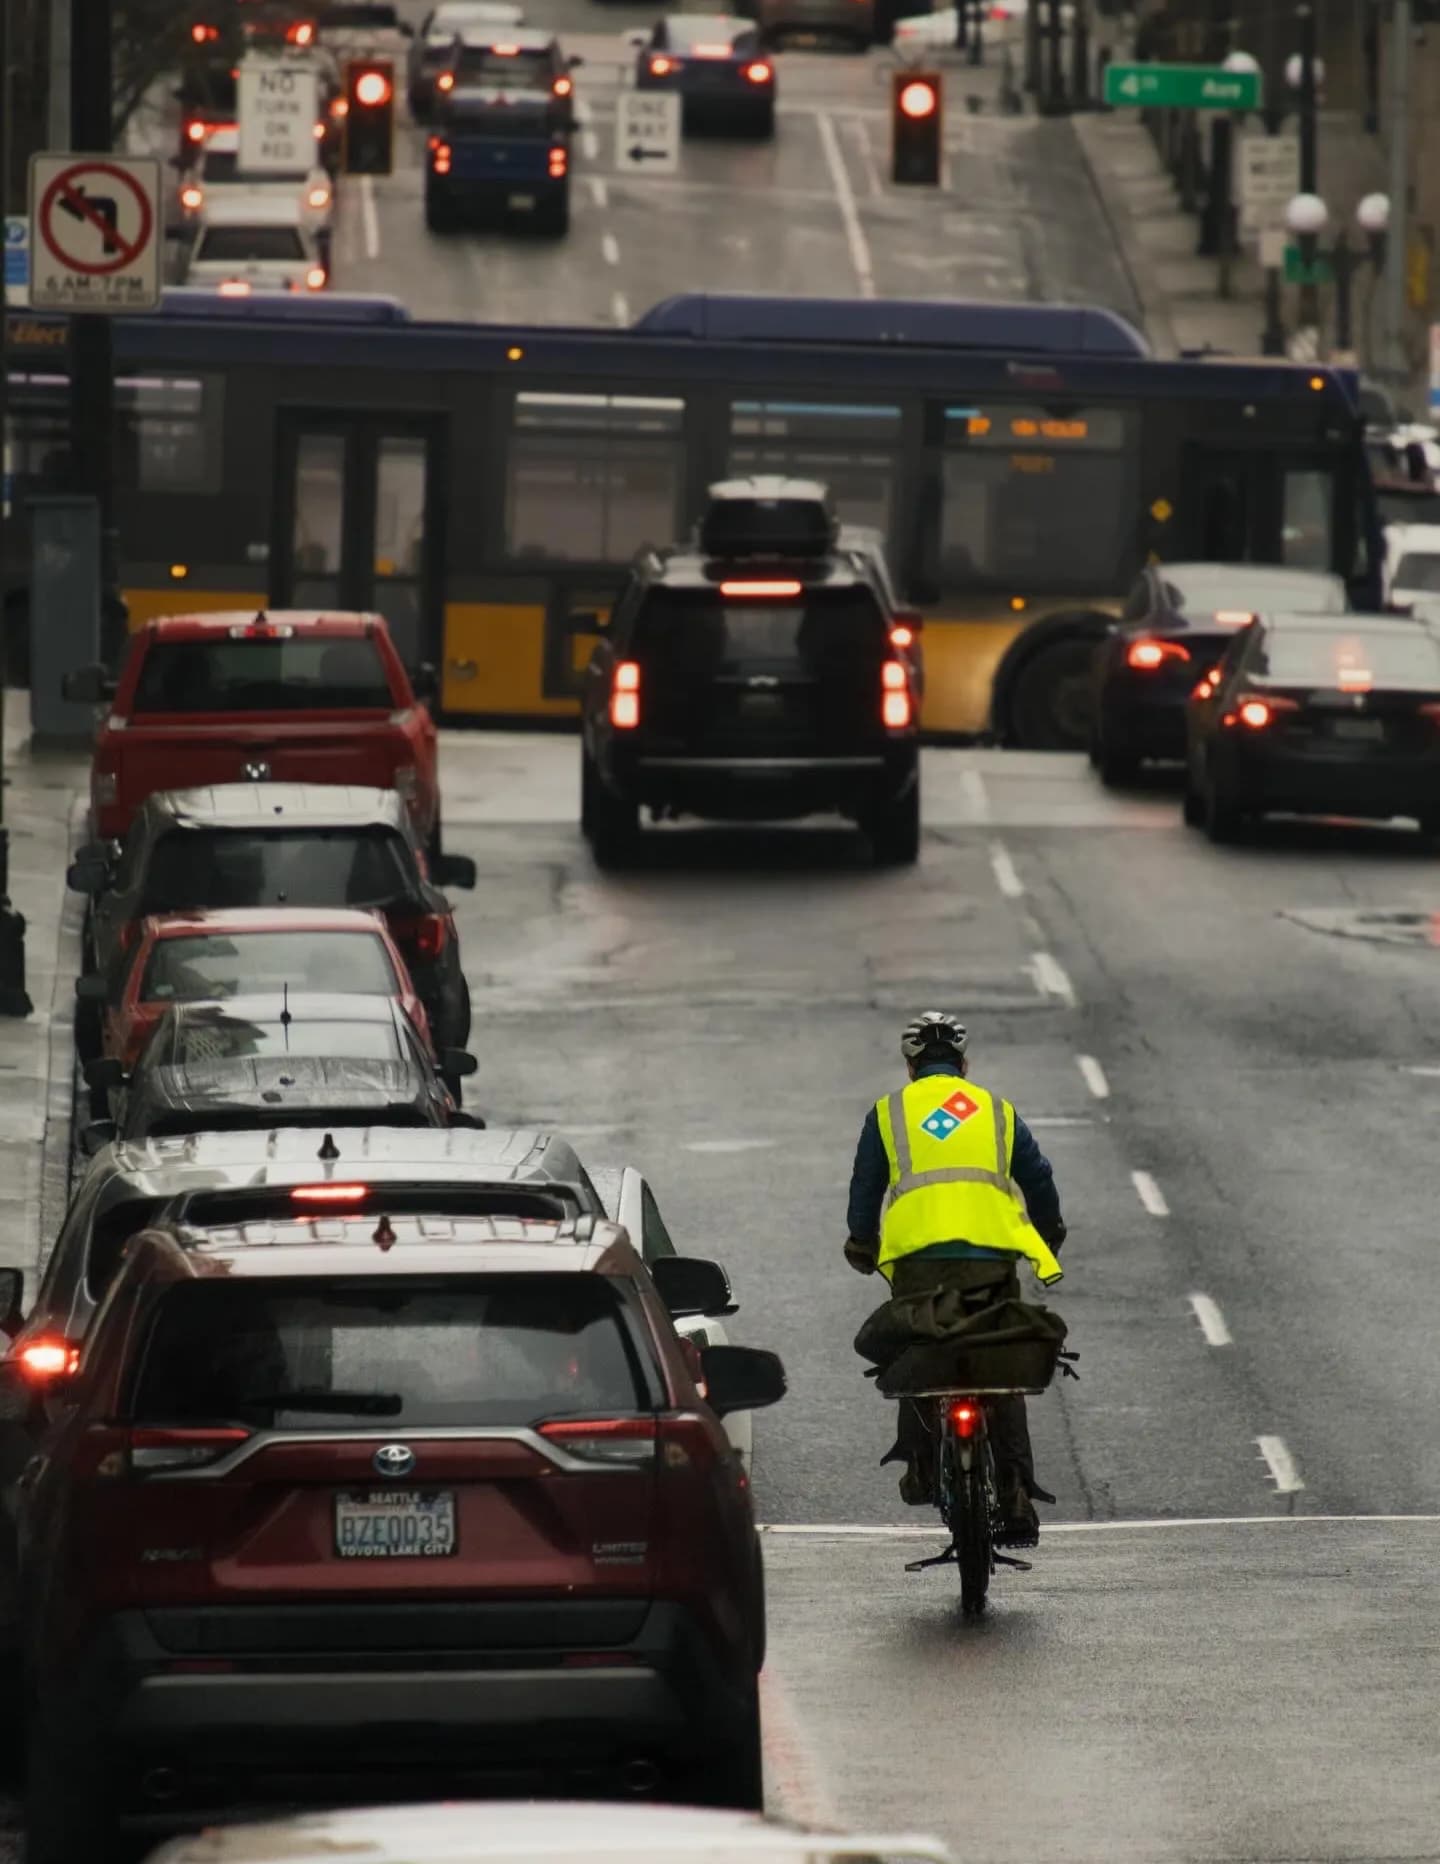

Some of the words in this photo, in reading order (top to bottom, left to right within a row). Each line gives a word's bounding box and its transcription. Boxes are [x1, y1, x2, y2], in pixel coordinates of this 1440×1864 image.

[260, 73, 296, 95] NO
[1202, 78, 1241, 98] Ave
[256, 98, 301, 116] TURN
[627, 99, 667, 117] ONE
[264, 121, 290, 137] ON
[627, 122, 669, 139] WAY
[261, 141, 297, 158] RED
[368, 1491, 420, 1504] SEATTLE
[341, 1514, 451, 1545] BZE0035
[340, 1544, 387, 1557] TOYOTA
[390, 1543, 420, 1556] LAKE
[424, 1542, 452, 1555] CITY
